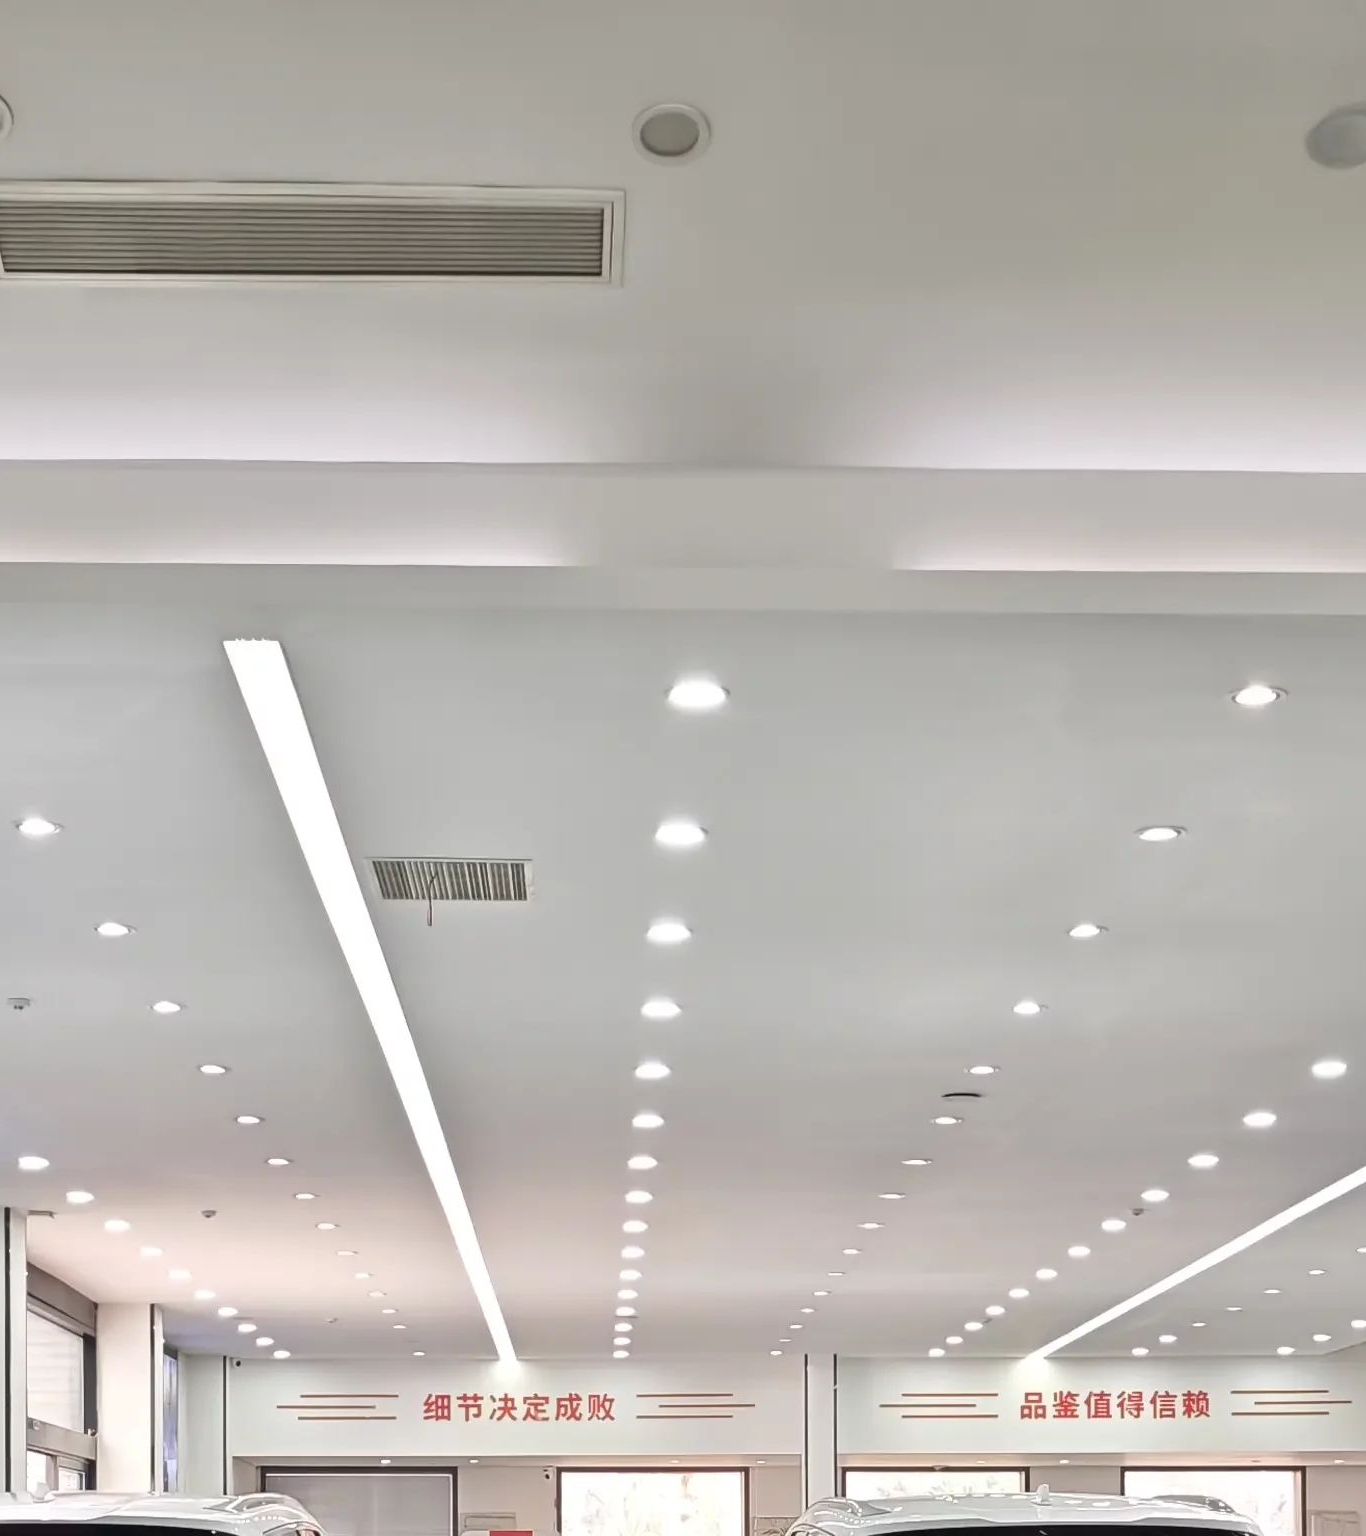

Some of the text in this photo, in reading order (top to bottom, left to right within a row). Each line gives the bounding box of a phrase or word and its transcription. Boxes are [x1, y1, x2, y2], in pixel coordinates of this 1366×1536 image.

[422, 1392, 616, 1422] 细节决定成败
[1019, 1390, 1211, 1420] 品鉴值得信赖
